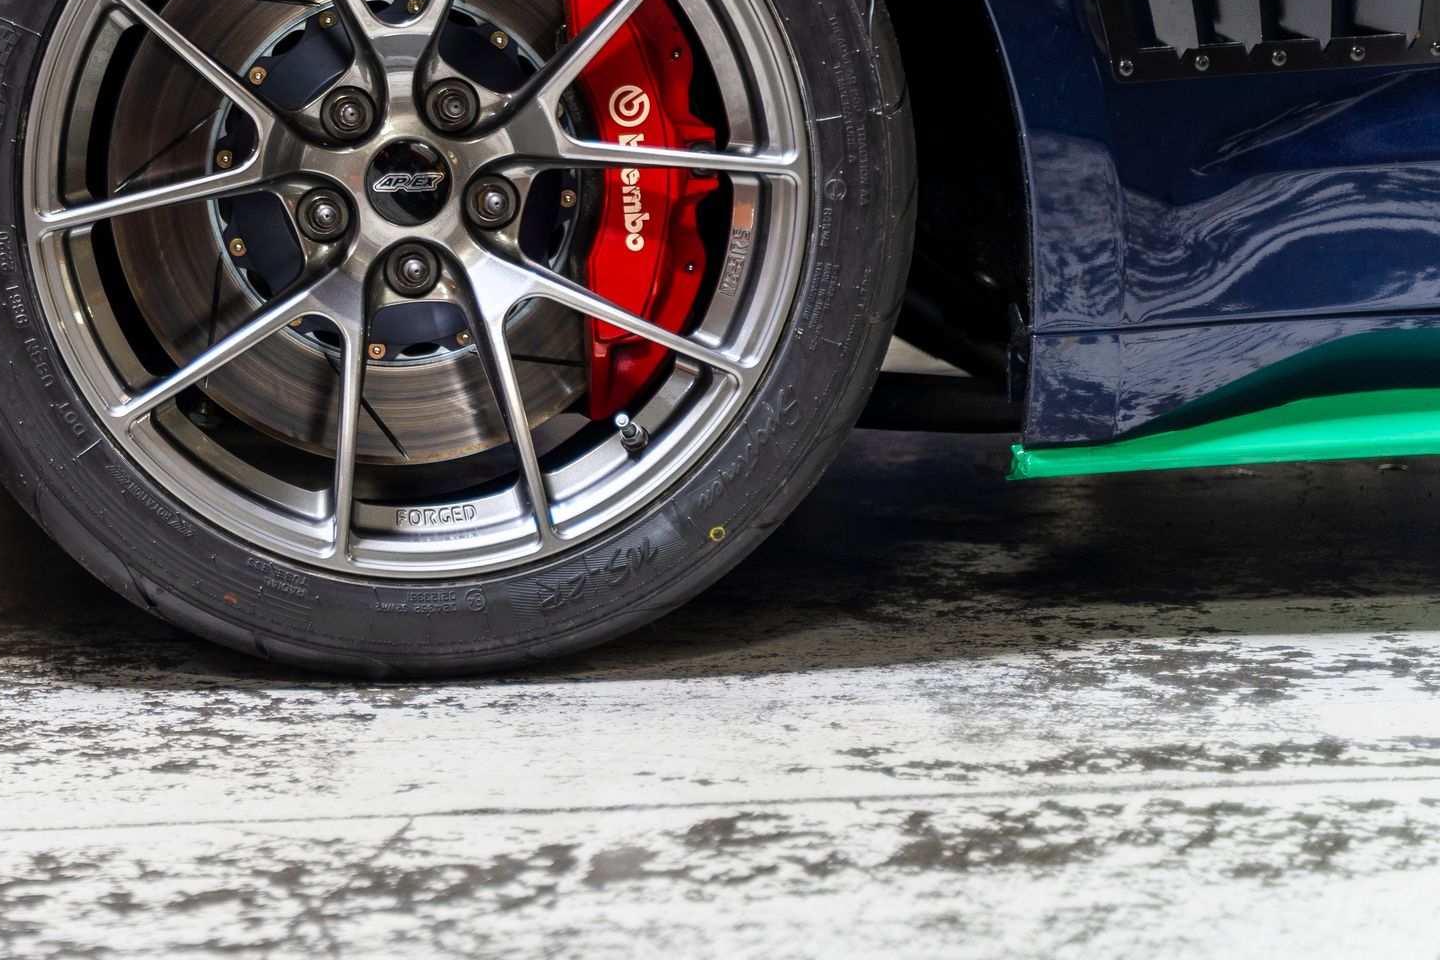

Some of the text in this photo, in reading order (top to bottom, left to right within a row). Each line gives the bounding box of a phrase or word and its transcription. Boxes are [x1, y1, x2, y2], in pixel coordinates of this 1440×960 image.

[375, 174, 441, 189] APEX
[618, 134, 650, 252] bembo
[54, 397, 88, 437] DOT
[395, 504, 478, 527] FORGED
[244, 556, 310, 587] TUBELESS
[261, 574, 306, 597] RADIAL
